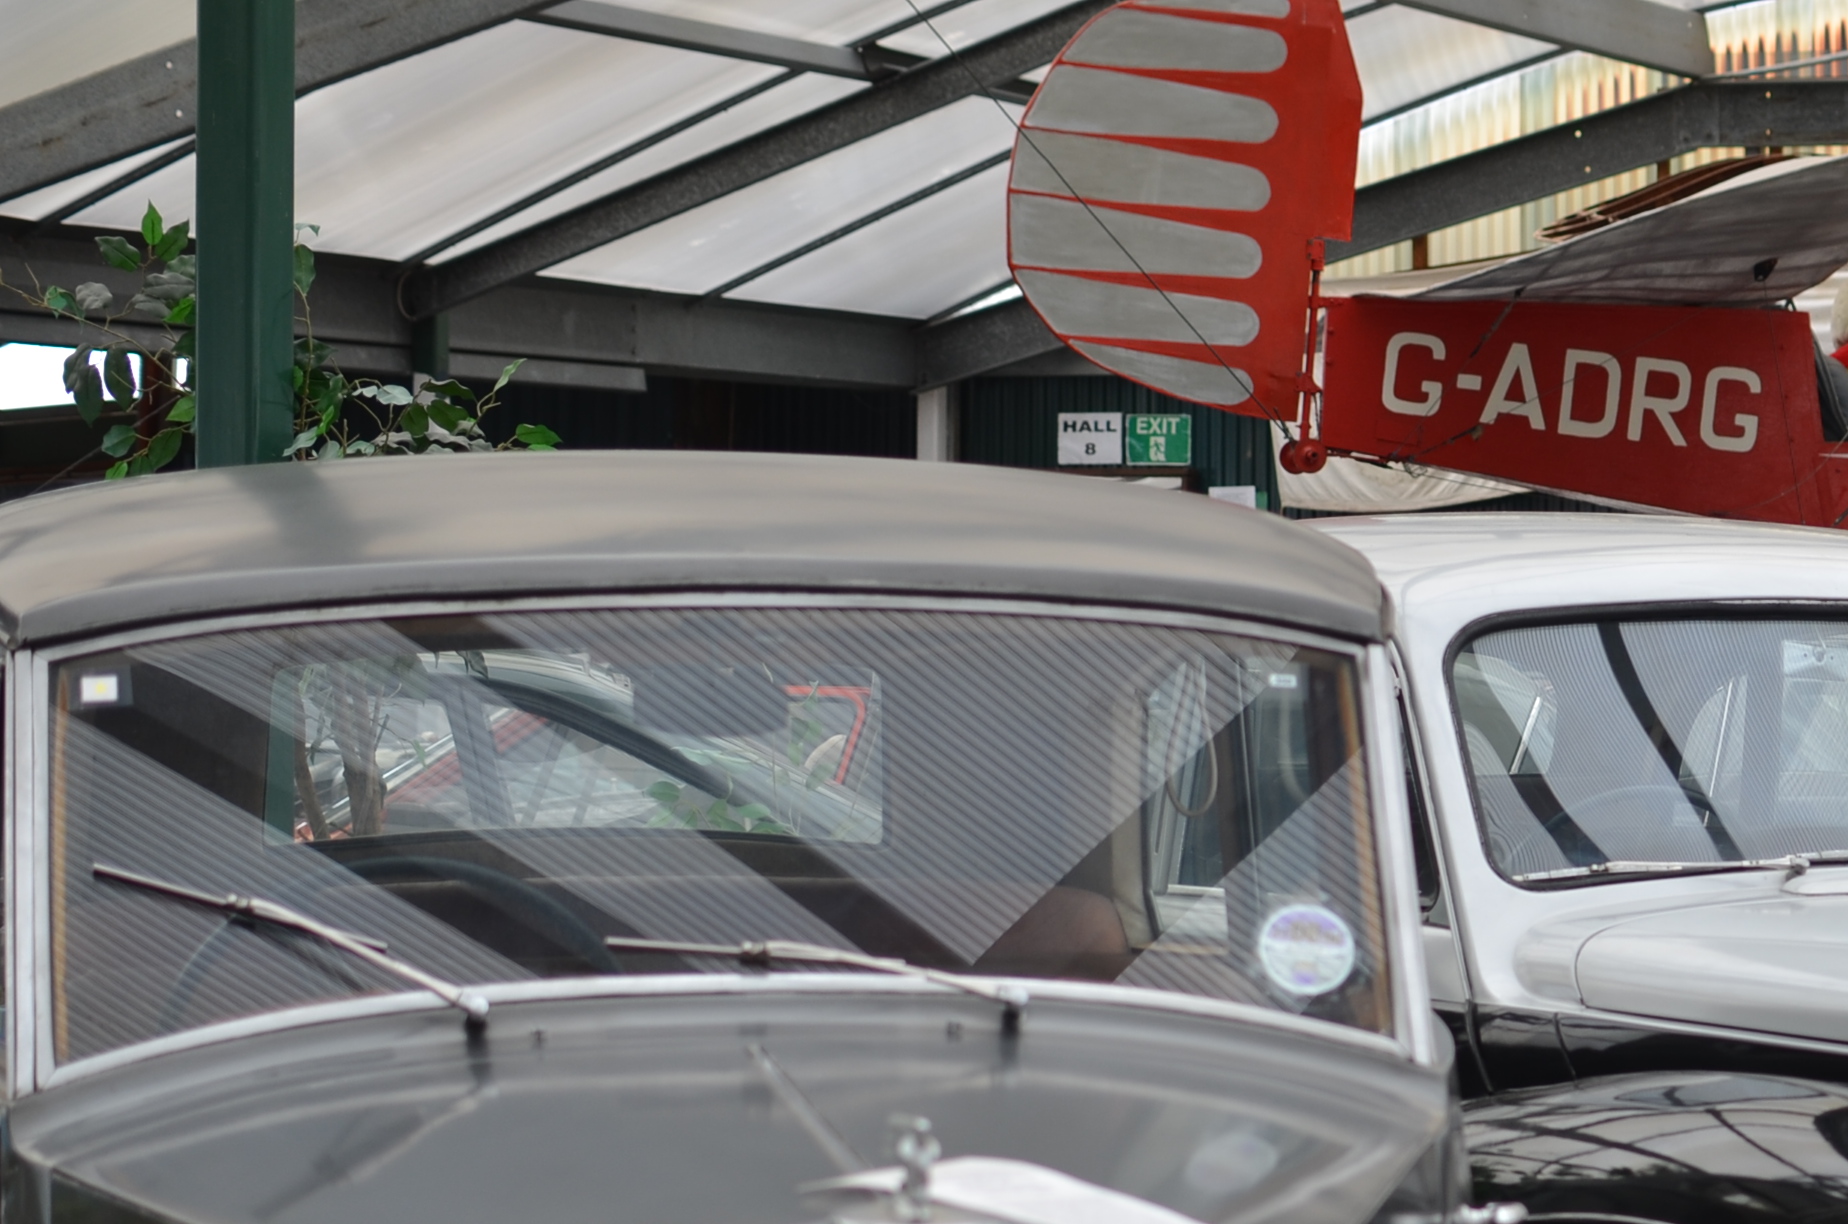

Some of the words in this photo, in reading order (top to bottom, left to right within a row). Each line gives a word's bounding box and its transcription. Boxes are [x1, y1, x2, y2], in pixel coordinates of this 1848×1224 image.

[1382, 332, 1761, 452] G-ADRG
[1063, 420, 1117, 433] HALL
[1136, 417, 1180, 435] EXIT
[1085, 443, 1096, 455] 8
